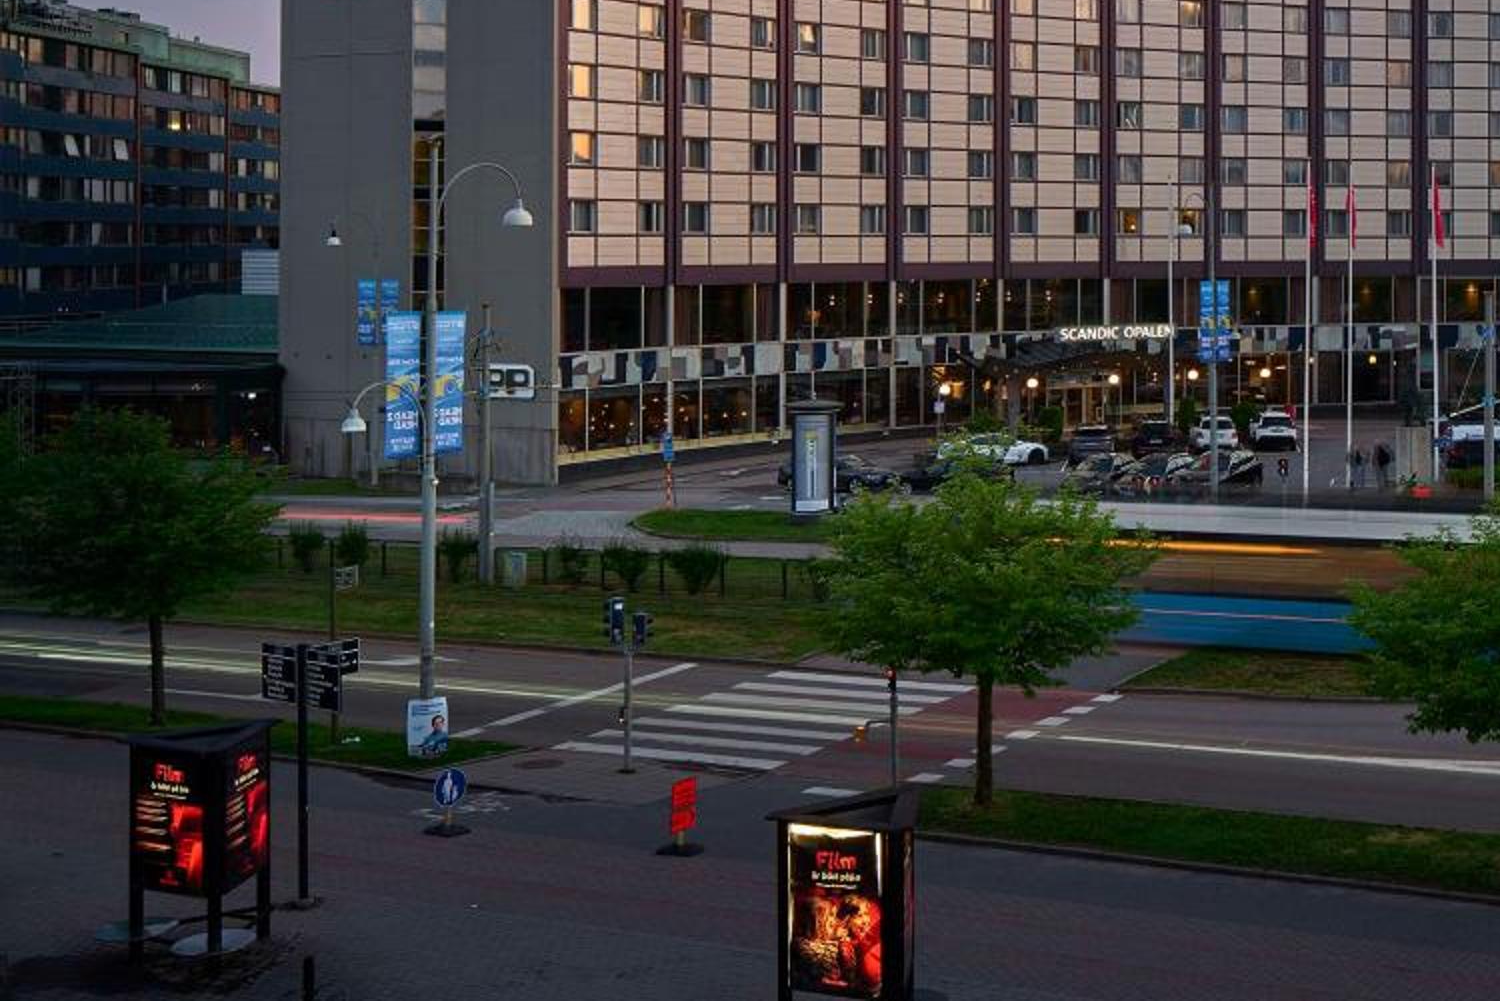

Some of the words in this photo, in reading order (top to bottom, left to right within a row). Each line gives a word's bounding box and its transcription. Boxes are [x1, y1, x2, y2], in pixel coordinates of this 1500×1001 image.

[1059, 326, 1120, 341] SCANDIC
[1123, 325, 1175, 339] OPALEN
[815, 851, 858, 871] Film
